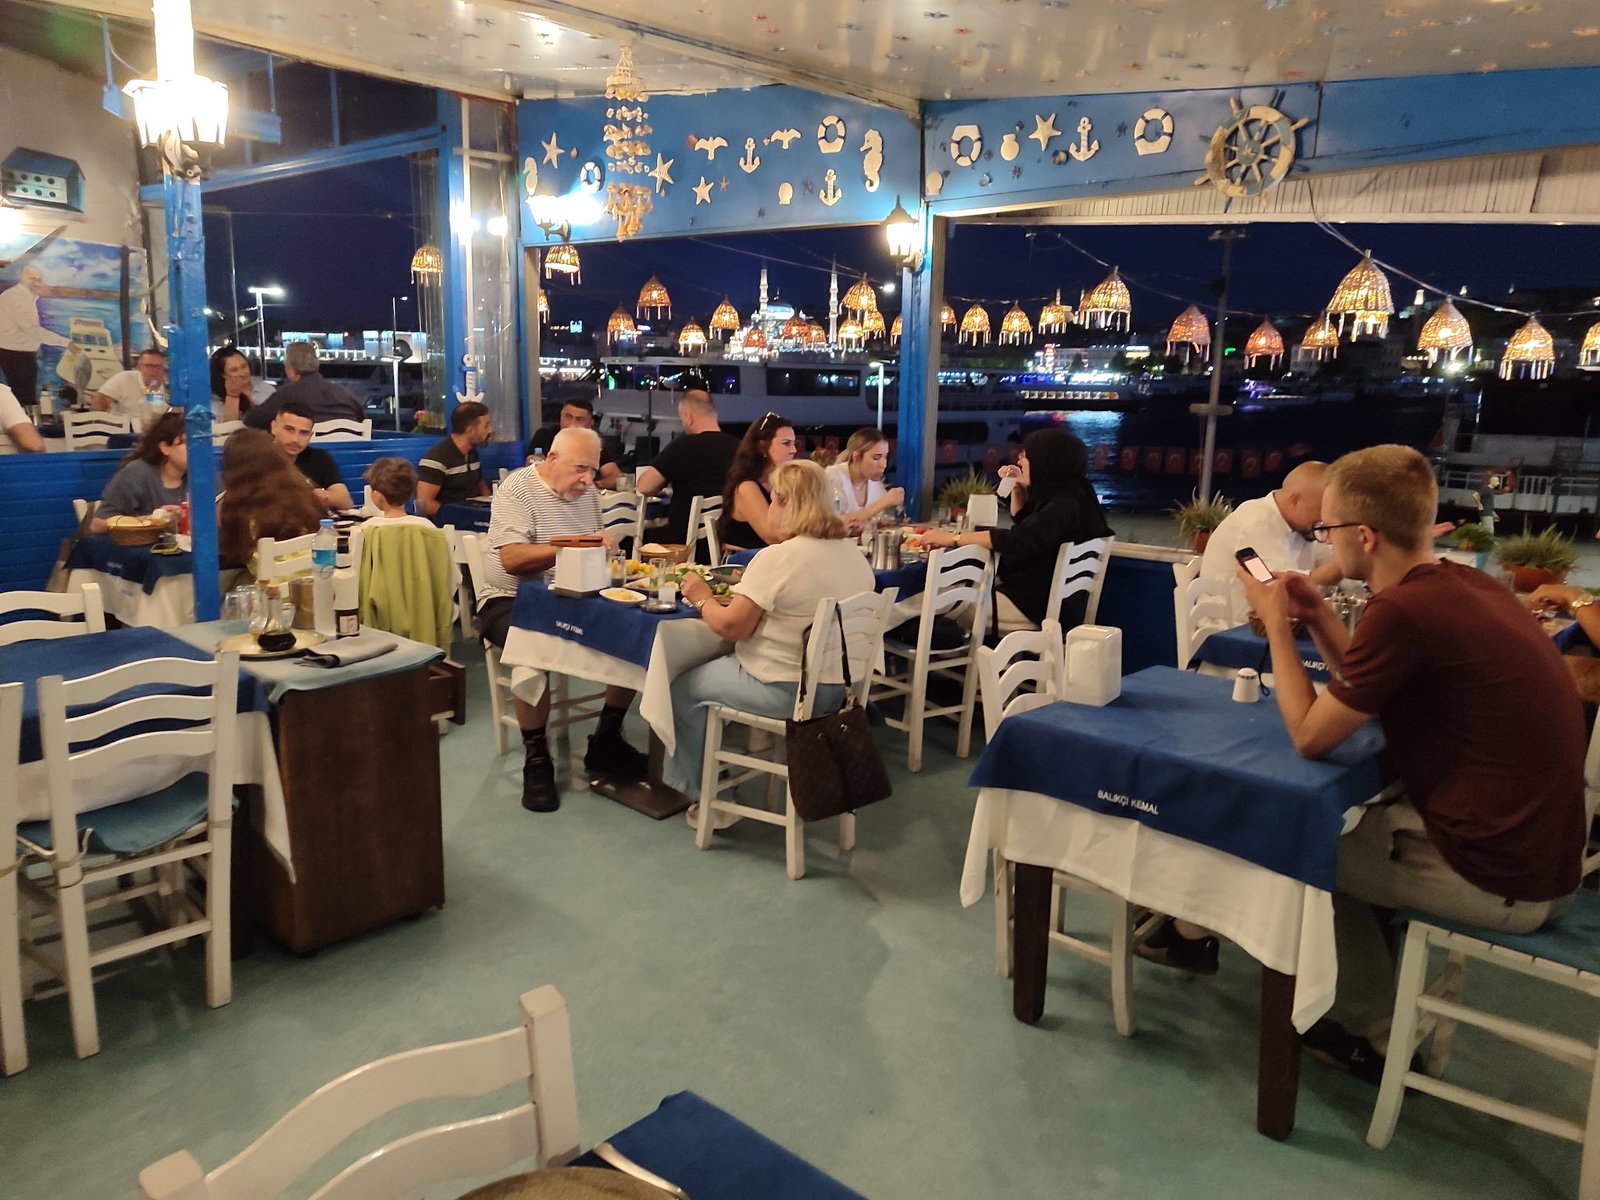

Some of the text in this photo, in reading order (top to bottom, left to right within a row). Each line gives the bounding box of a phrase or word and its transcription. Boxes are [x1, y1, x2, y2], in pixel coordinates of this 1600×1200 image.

[1302, 660, 1326, 671] ALIKÇI
[1097, 789, 1159, 815] BALIKÇI KEMAL
